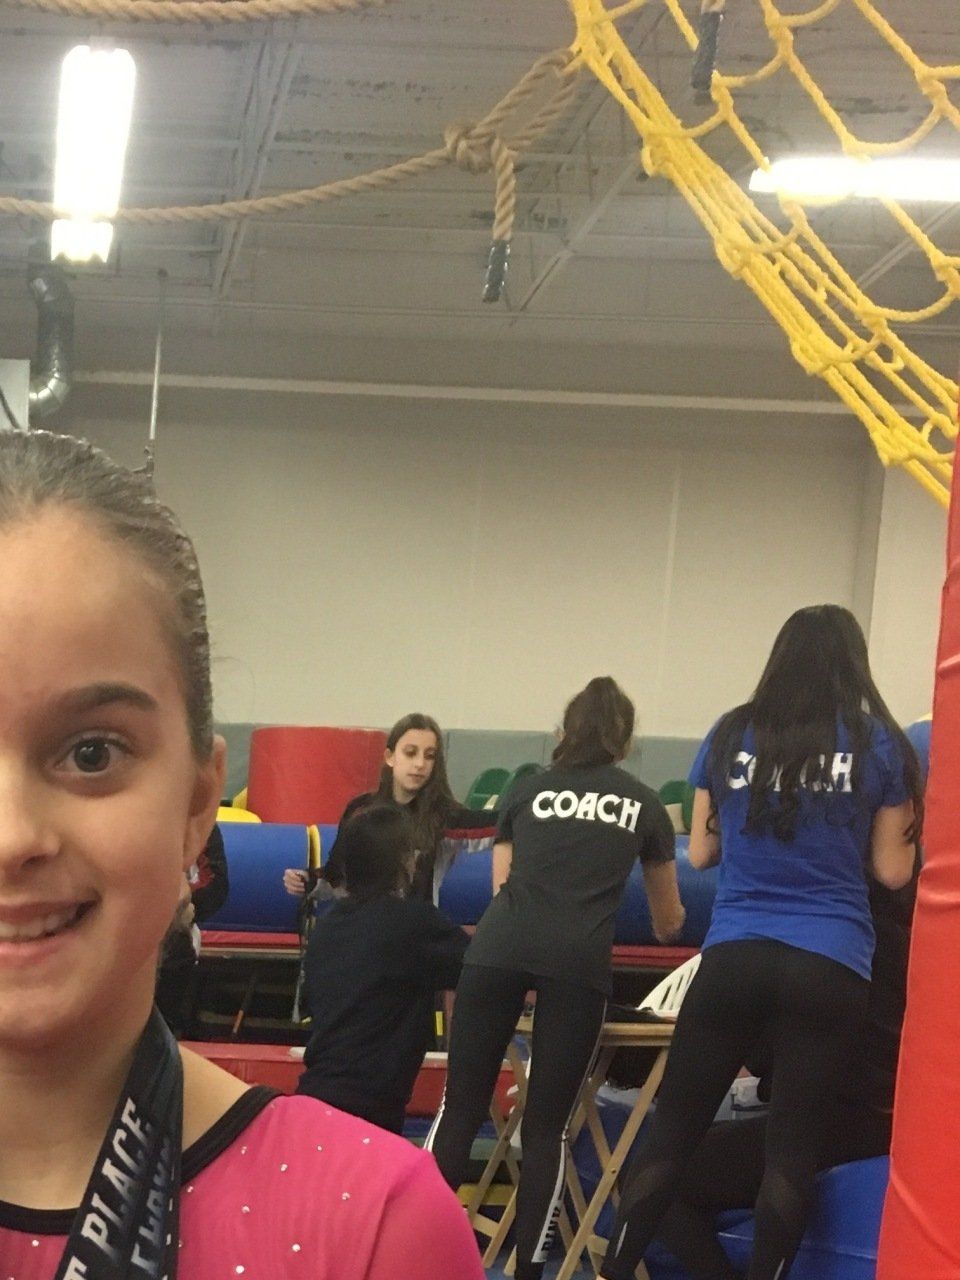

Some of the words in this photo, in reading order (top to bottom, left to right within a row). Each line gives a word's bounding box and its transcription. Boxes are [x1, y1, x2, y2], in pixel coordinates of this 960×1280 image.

[725, 751, 854, 793] CCH
[532, 790, 642, 833] COACH
[81, 1097, 151, 1262] PLACE
